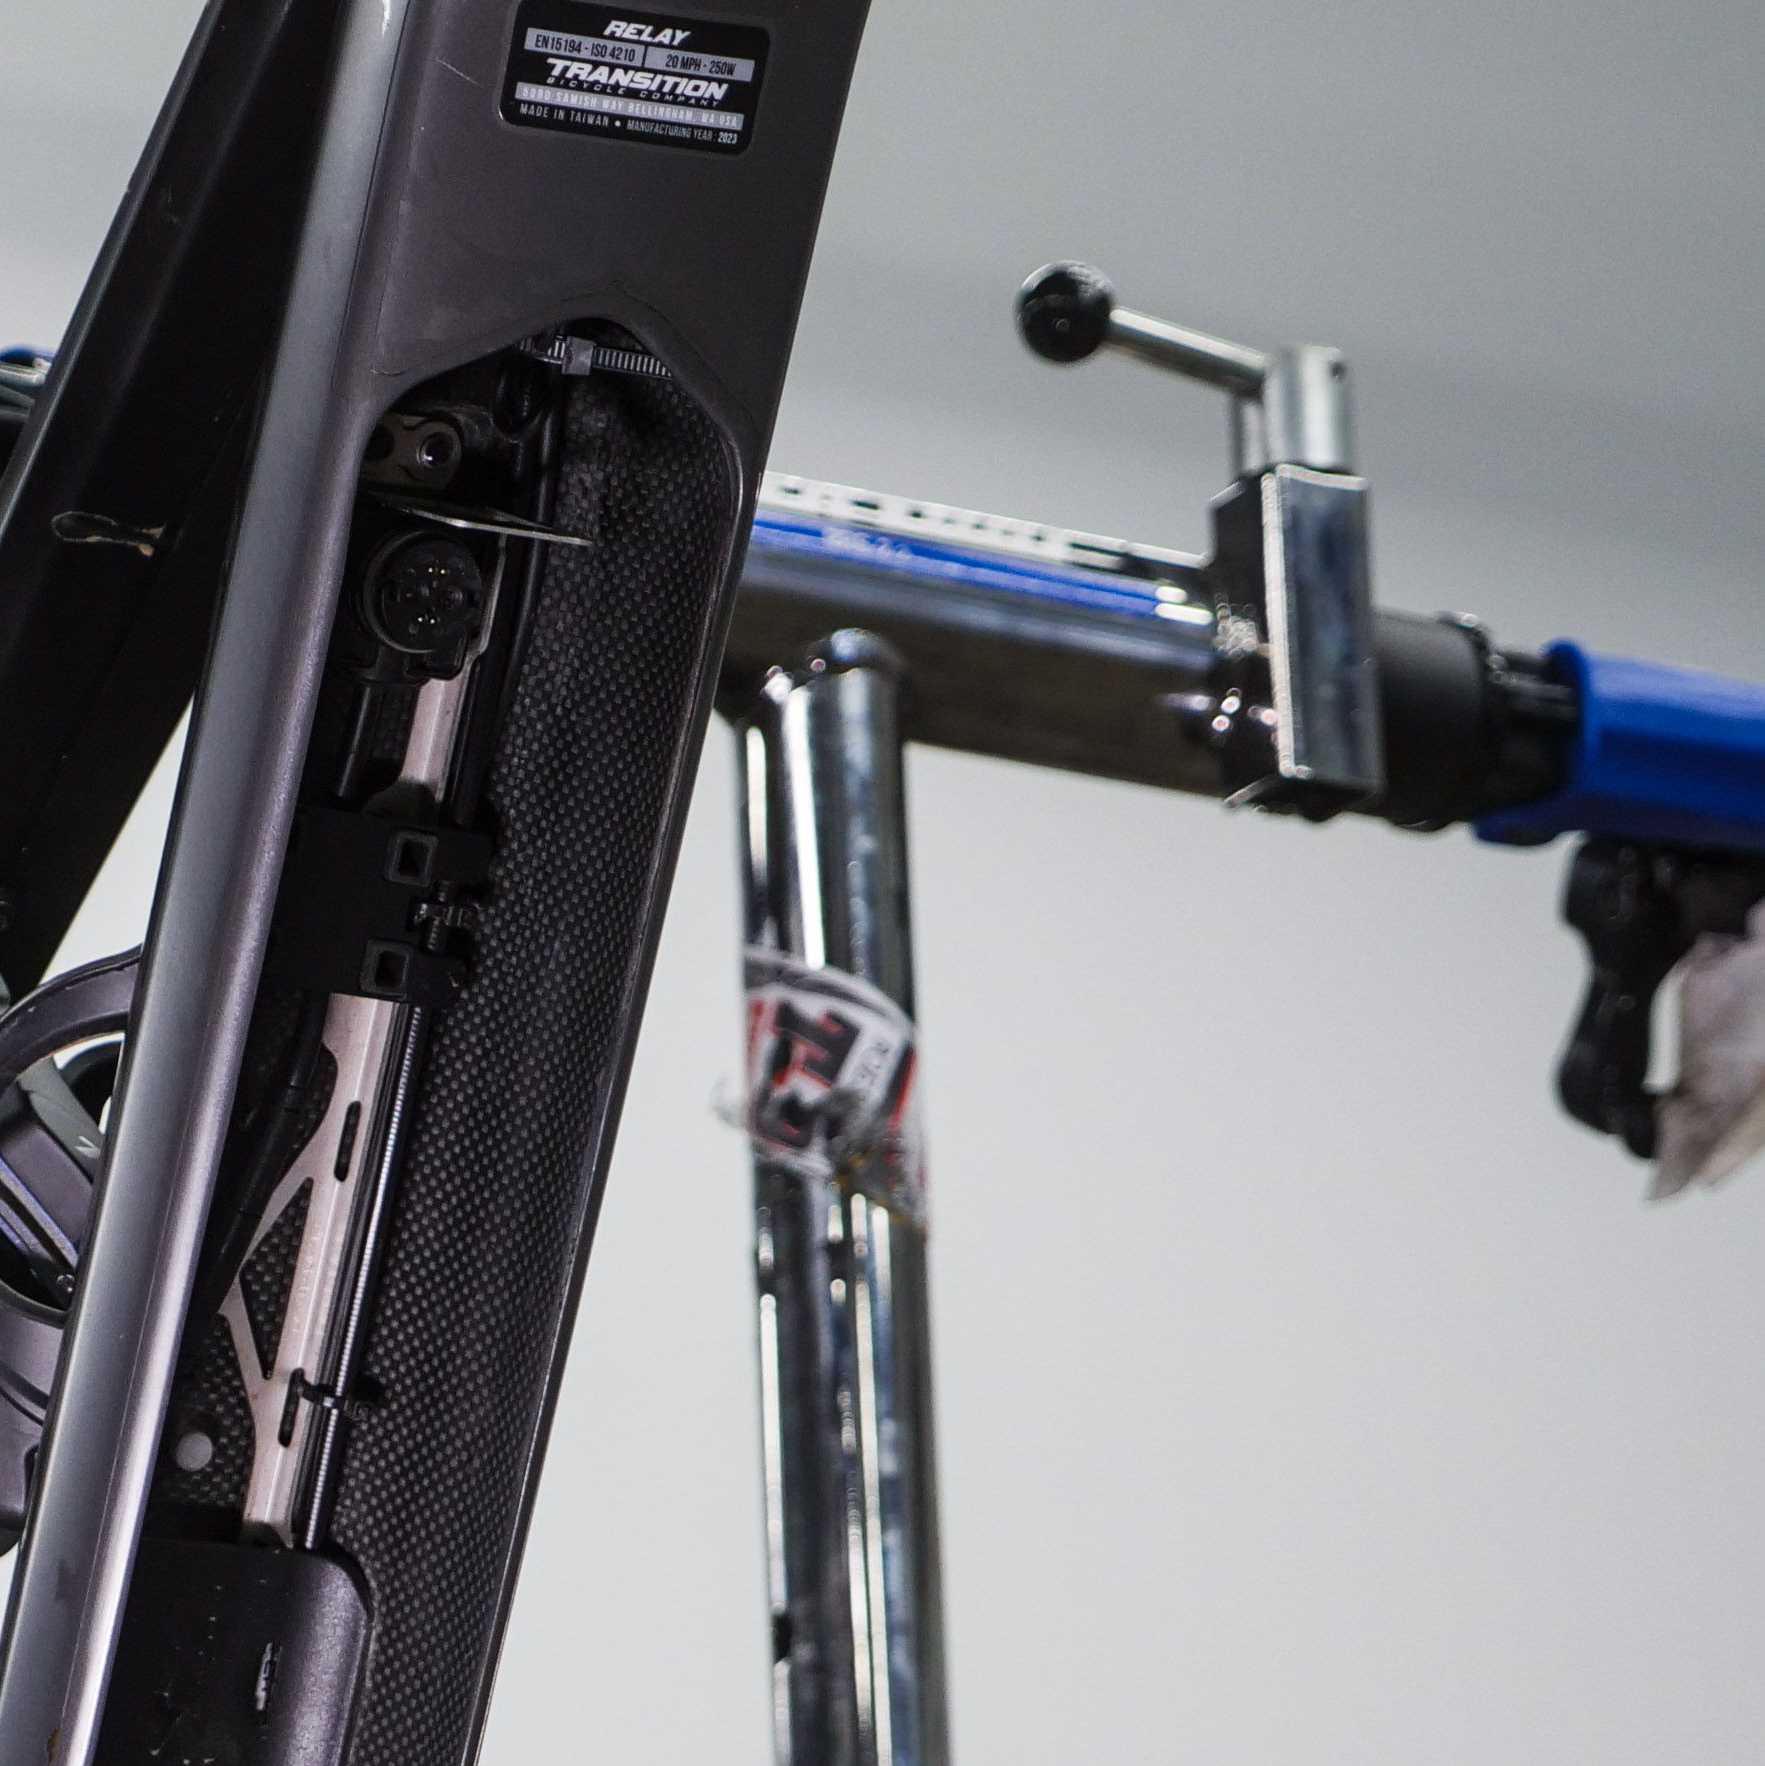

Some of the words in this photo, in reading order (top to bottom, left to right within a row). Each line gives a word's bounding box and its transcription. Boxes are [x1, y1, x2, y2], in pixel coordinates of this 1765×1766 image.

[603, 20, 691, 46] RELAY
[591, 43, 608, 58] ISO
[609, 46, 636, 62] 4210
[665, 54, 678, 69] 20
[680, 56, 701, 71] MPH
[709, 60, 736, 76] 250W
[546, 57, 729, 100] TRANSITION
[546, 76, 626, 95] BICYCLE
[640, 91, 719, 107] COMPANY
[520, 103, 549, 118] MADE
[554, 109, 565, 119] IN
[570, 111, 609, 127] TAIWAN
[556, 92, 597, 107] SAMISH
[602, 100, 623, 111] WAY
[719, 114, 737, 127] USA
[627, 119, 691, 138] MANUFACTURING
[718, 132, 737, 144] 2023
